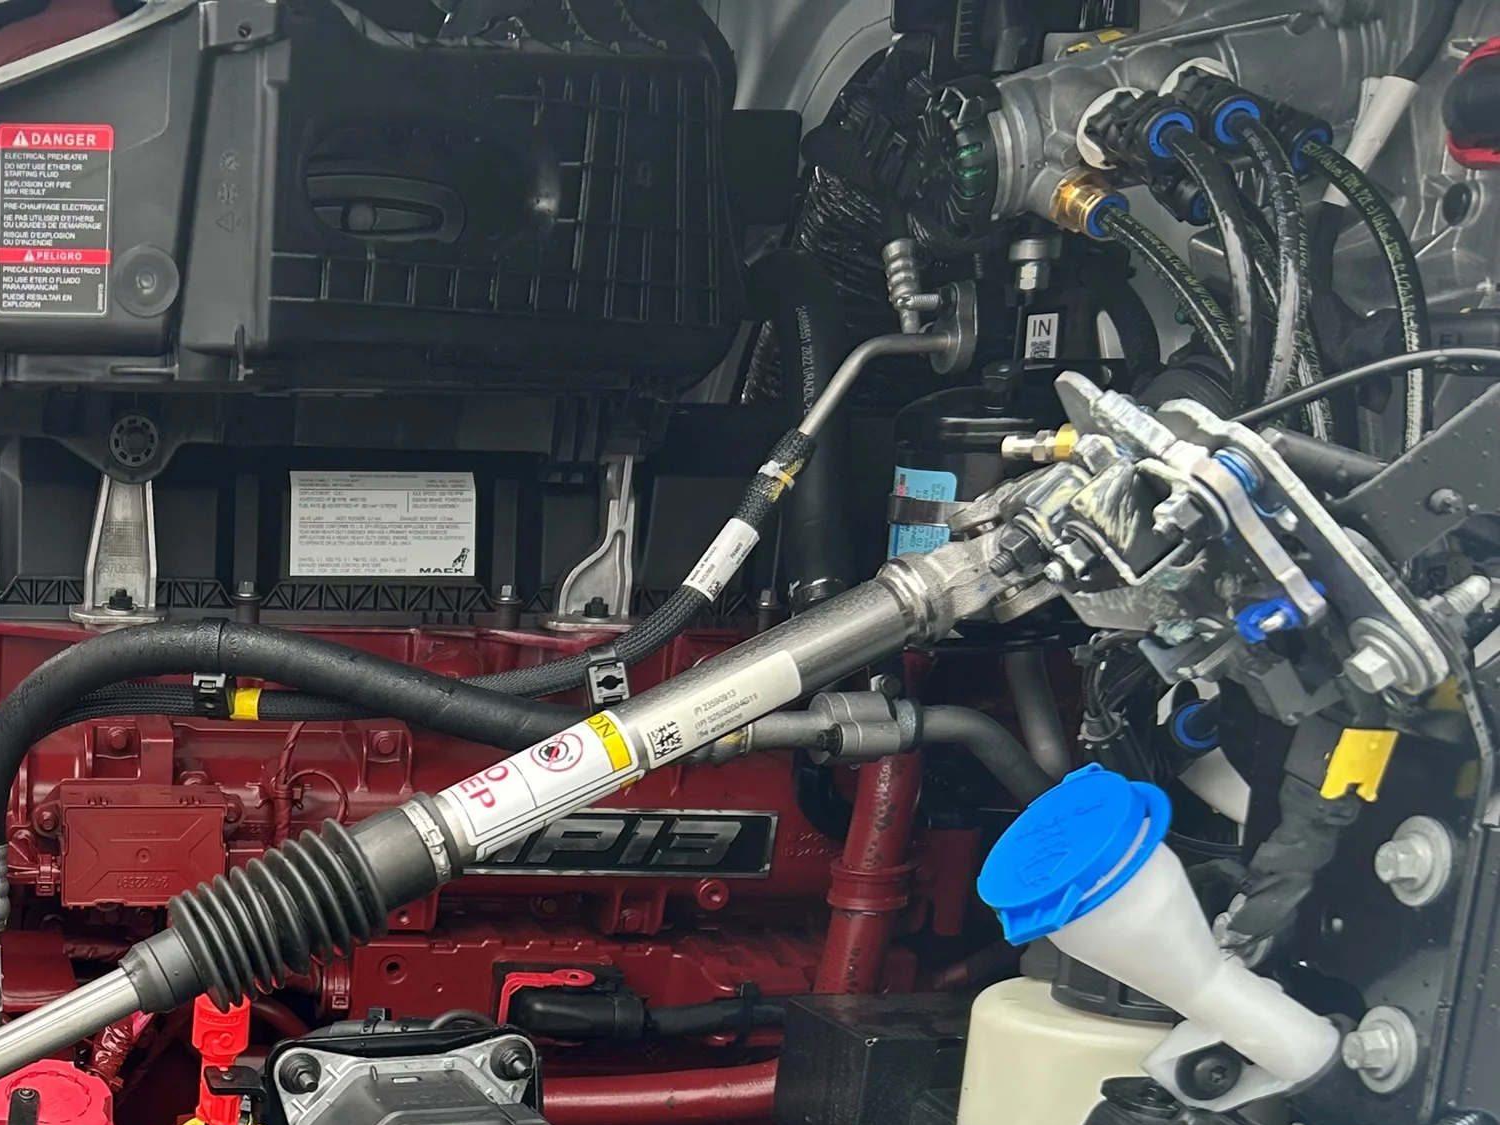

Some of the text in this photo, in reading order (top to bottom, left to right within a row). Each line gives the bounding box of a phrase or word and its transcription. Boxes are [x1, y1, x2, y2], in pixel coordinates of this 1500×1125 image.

[31, 132, 96, 146] DANGER
[4, 152, 46, 160] ELECTRICAL
[4, 180, 43, 188] EXPLOSION
[3, 231, 29, 239] RISQUE
[36, 251, 83, 260] PELIGRO
[3, 266, 60, 274] PRECALENTADOR
[1032, 318, 1051, 337] IN
